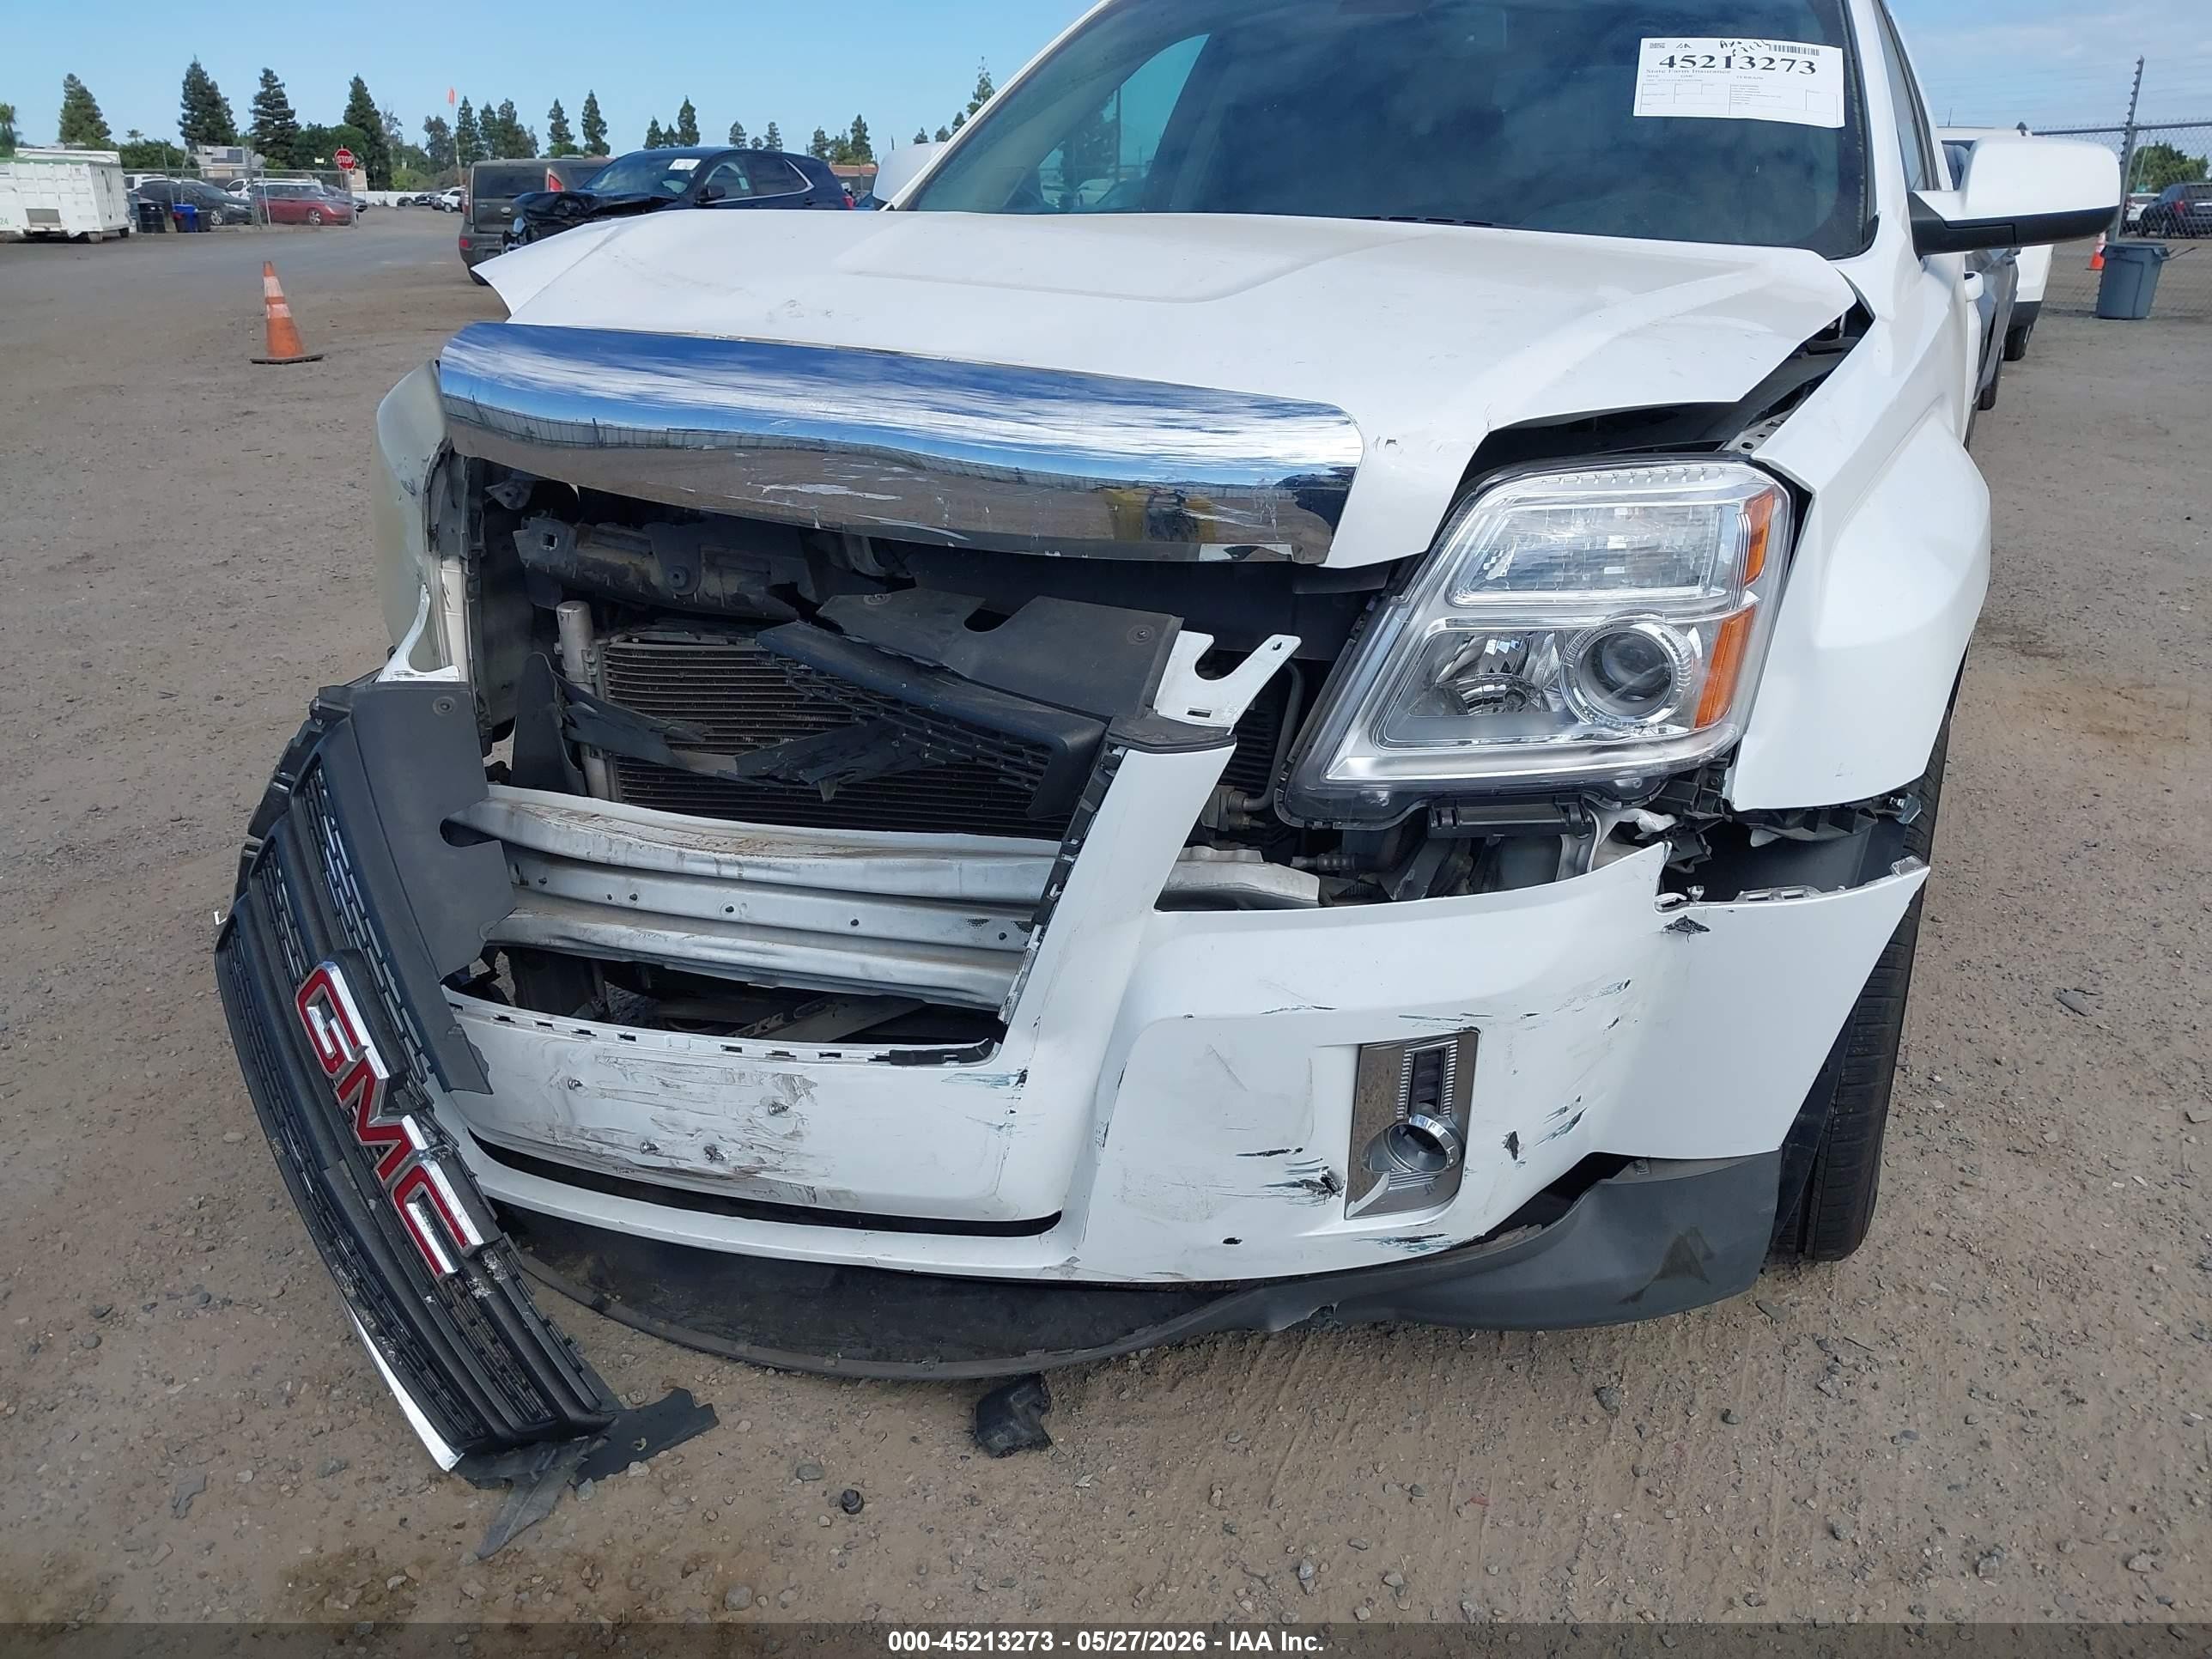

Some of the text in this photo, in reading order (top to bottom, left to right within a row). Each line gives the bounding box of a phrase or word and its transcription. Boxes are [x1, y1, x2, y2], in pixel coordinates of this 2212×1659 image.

[1658, 54, 1817, 76] 45213273
[337, 155, 354, 164] STOP
[295, 960, 484, 1282] GMC
